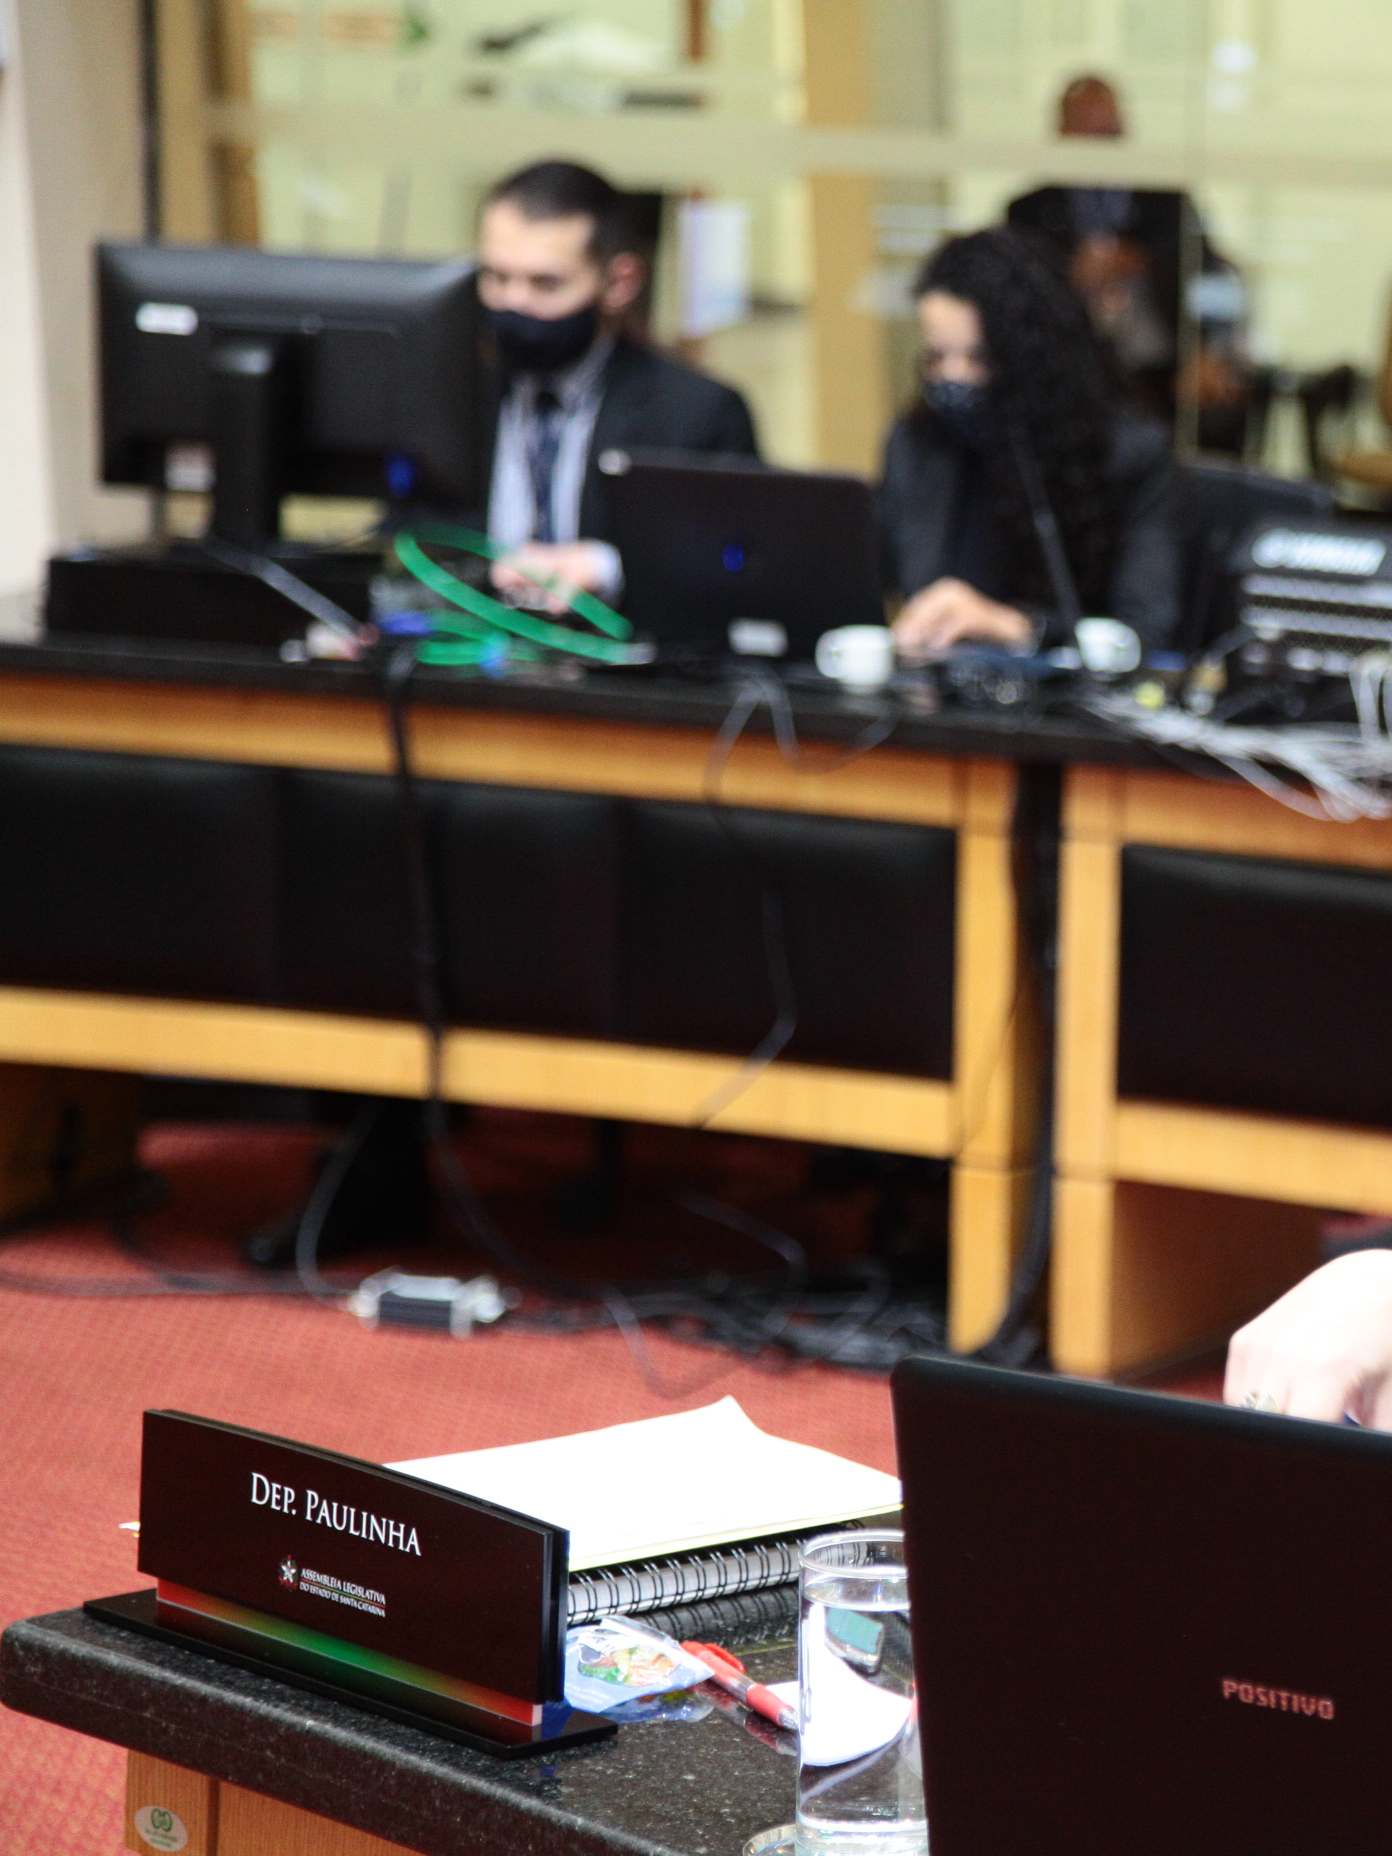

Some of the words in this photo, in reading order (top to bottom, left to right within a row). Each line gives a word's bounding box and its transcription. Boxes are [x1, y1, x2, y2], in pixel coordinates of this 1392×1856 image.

[305, 1489, 422, 1557] PAULINHA
[299, 1581, 310, 1592] DO
[309, 1585, 332, 1600] ESTADO
[331, 1592, 340, 1603] DE
[339, 1595, 358, 1609] SANTA
[357, 1600, 386, 1618] CATARINA
[300, 1568, 342, 1591] ASSEMBLEIA
[342, 1581, 386, 1605] LEGISLATIVA
[1221, 1679, 1335, 1720] POSITIVO
